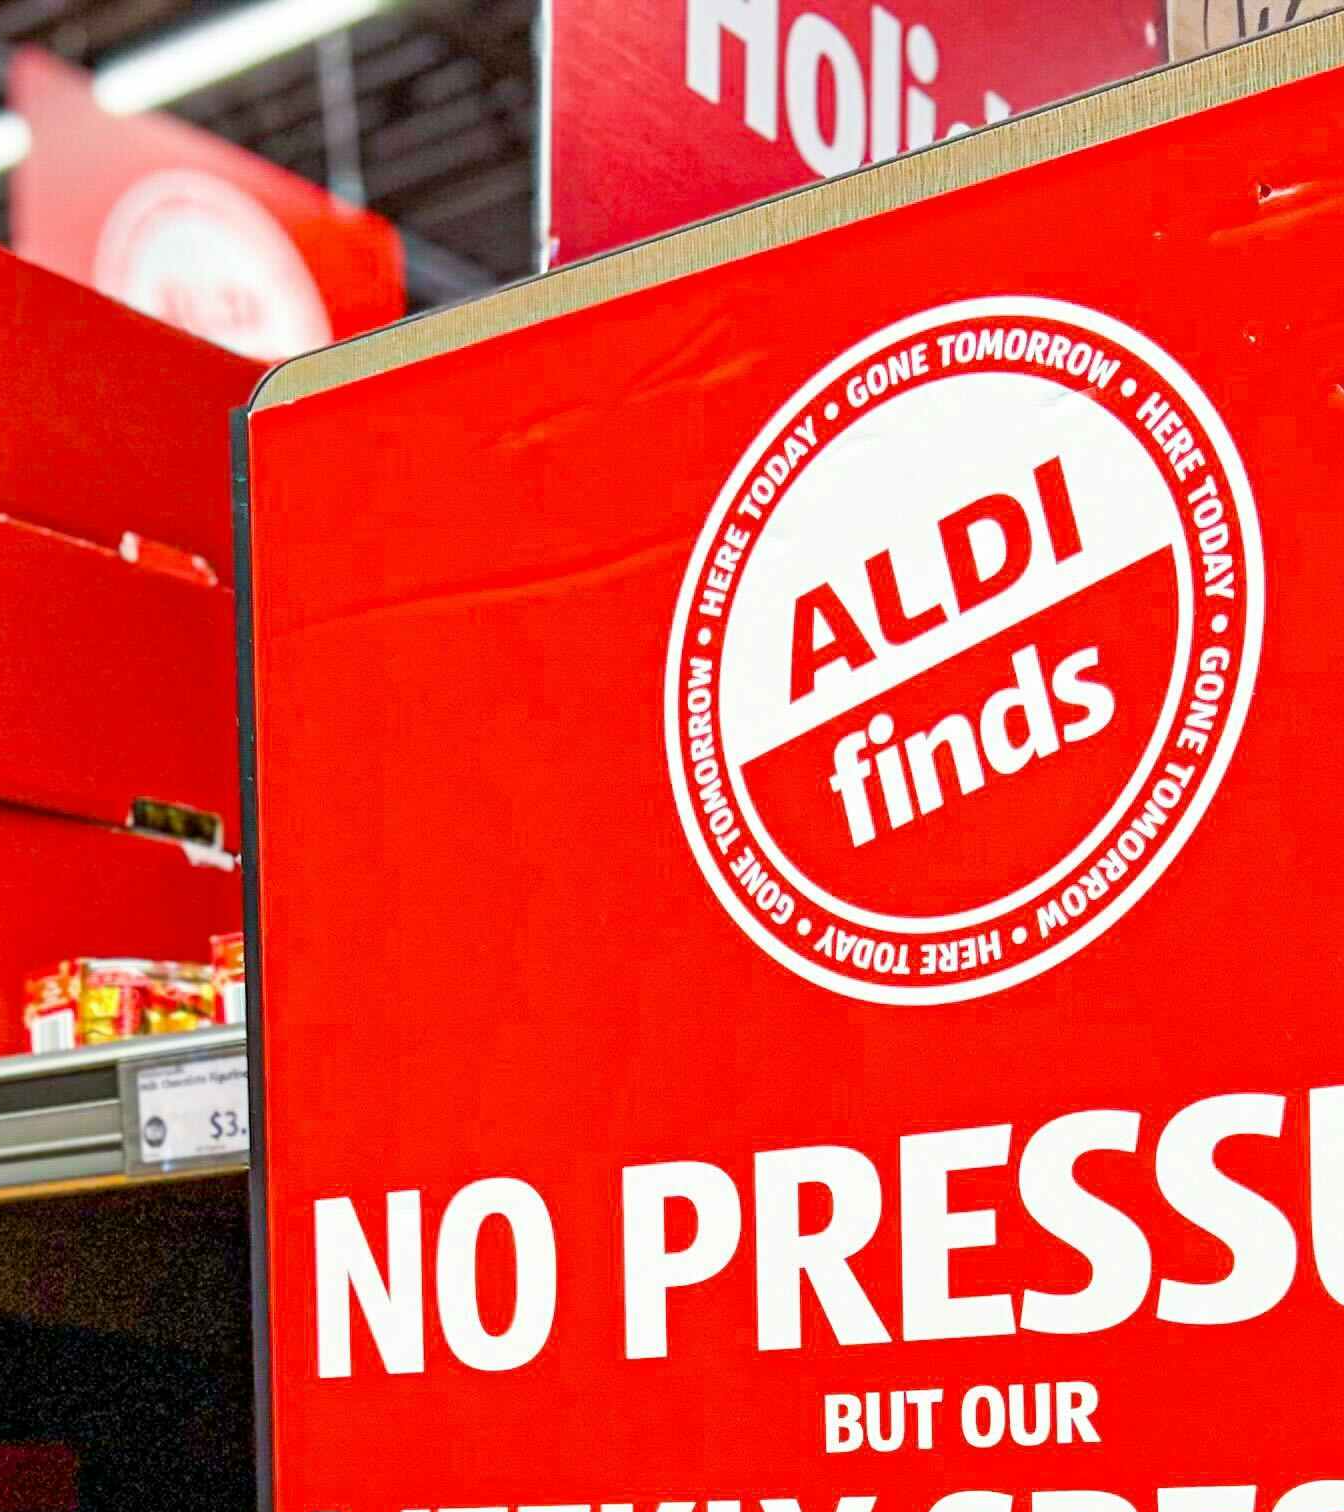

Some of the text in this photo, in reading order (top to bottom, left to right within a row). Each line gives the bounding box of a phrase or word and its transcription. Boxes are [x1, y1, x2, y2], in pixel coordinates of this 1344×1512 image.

[686, 0, 1012, 178] Holi
[688, 328, 1234, 974] HERE TODAY GONE TOMORROW HERE TODAY GONE TOMORROW HERE TODAY GONE TOMORROW
[790, 456, 1083, 704] ALDI
[830, 645, 1114, 847] finds
[315, 1178, 556, 1378] NO
[825, 1382, 1101, 1453] BUT OUR
